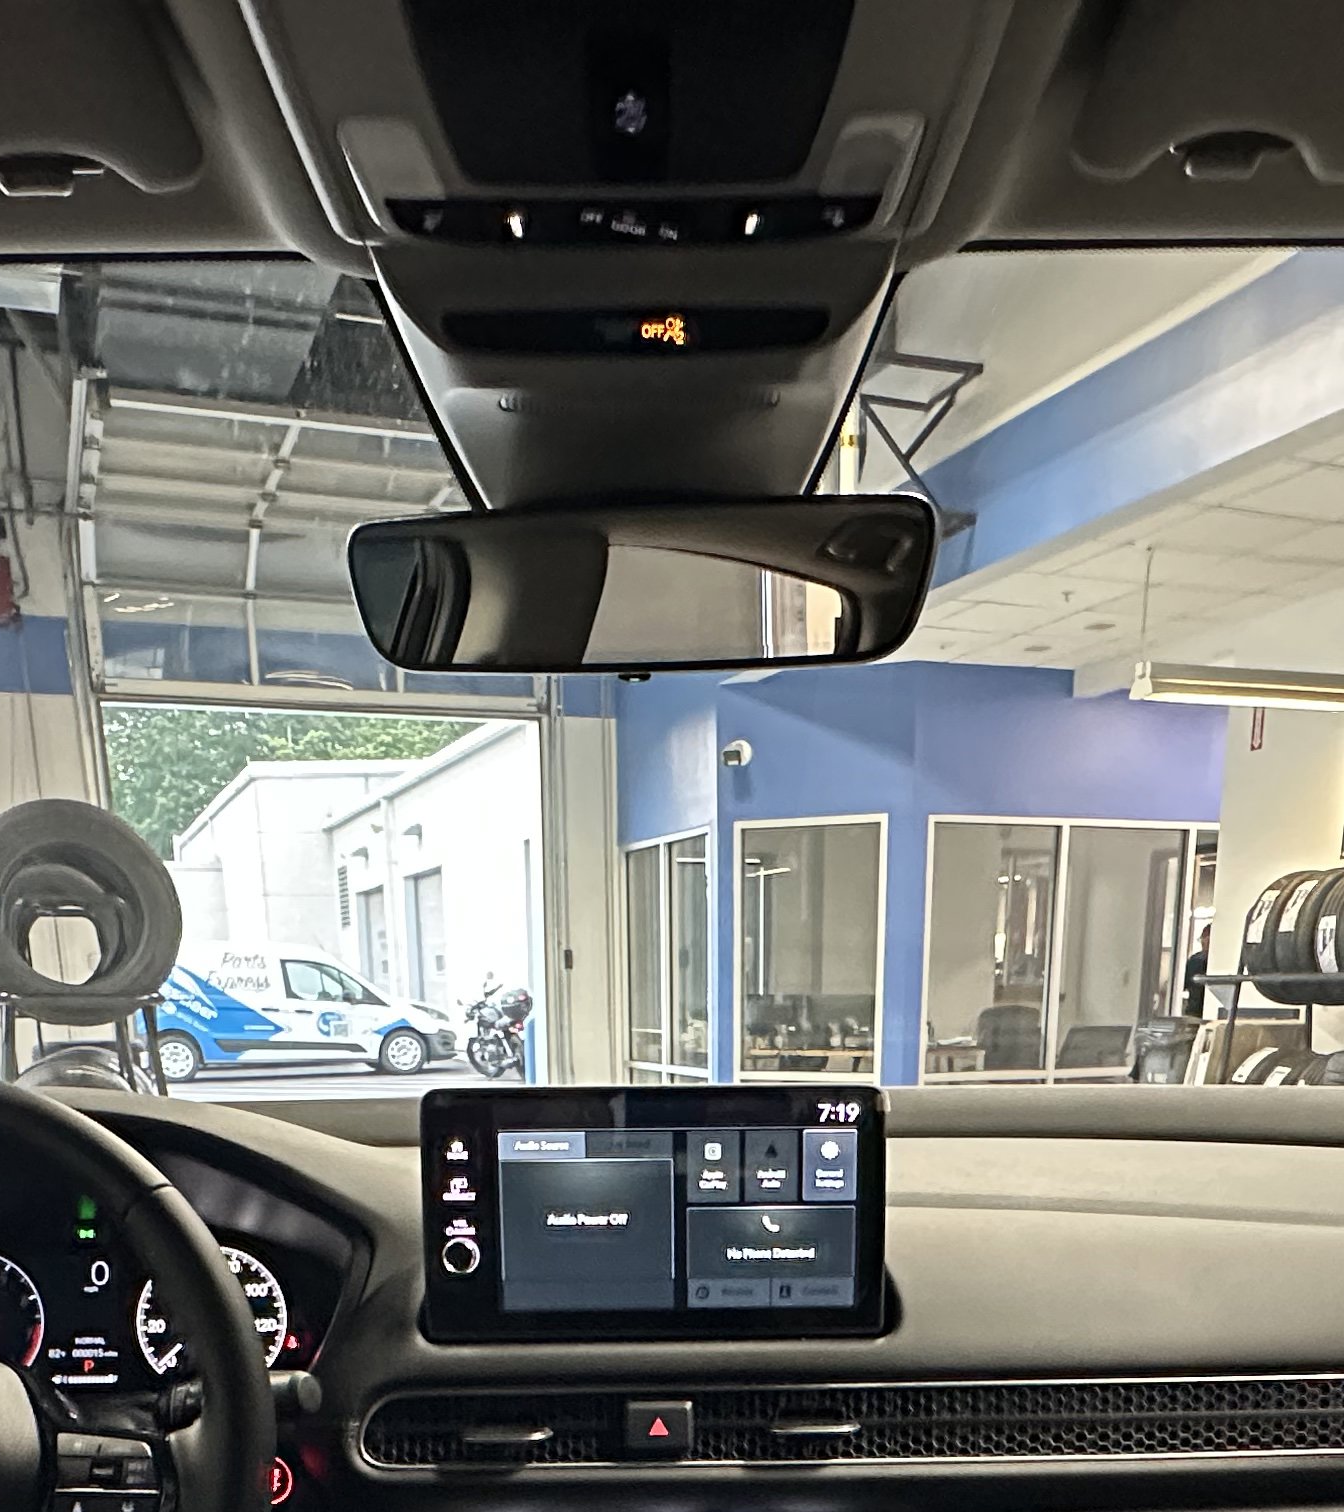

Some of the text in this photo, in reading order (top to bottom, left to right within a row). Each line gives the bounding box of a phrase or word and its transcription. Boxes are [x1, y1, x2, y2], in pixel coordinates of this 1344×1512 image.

[641, 323, 665, 339] OFF
[817, 1102, 860, 1123] 7:19
[90, 1260, 110, 1287] 0
[245, 1283, 269, 1298] 100
[147, 1318, 167, 1334] 20
[254, 1318, 278, 1333] 120
[84, 1360, 95, 1373] P
